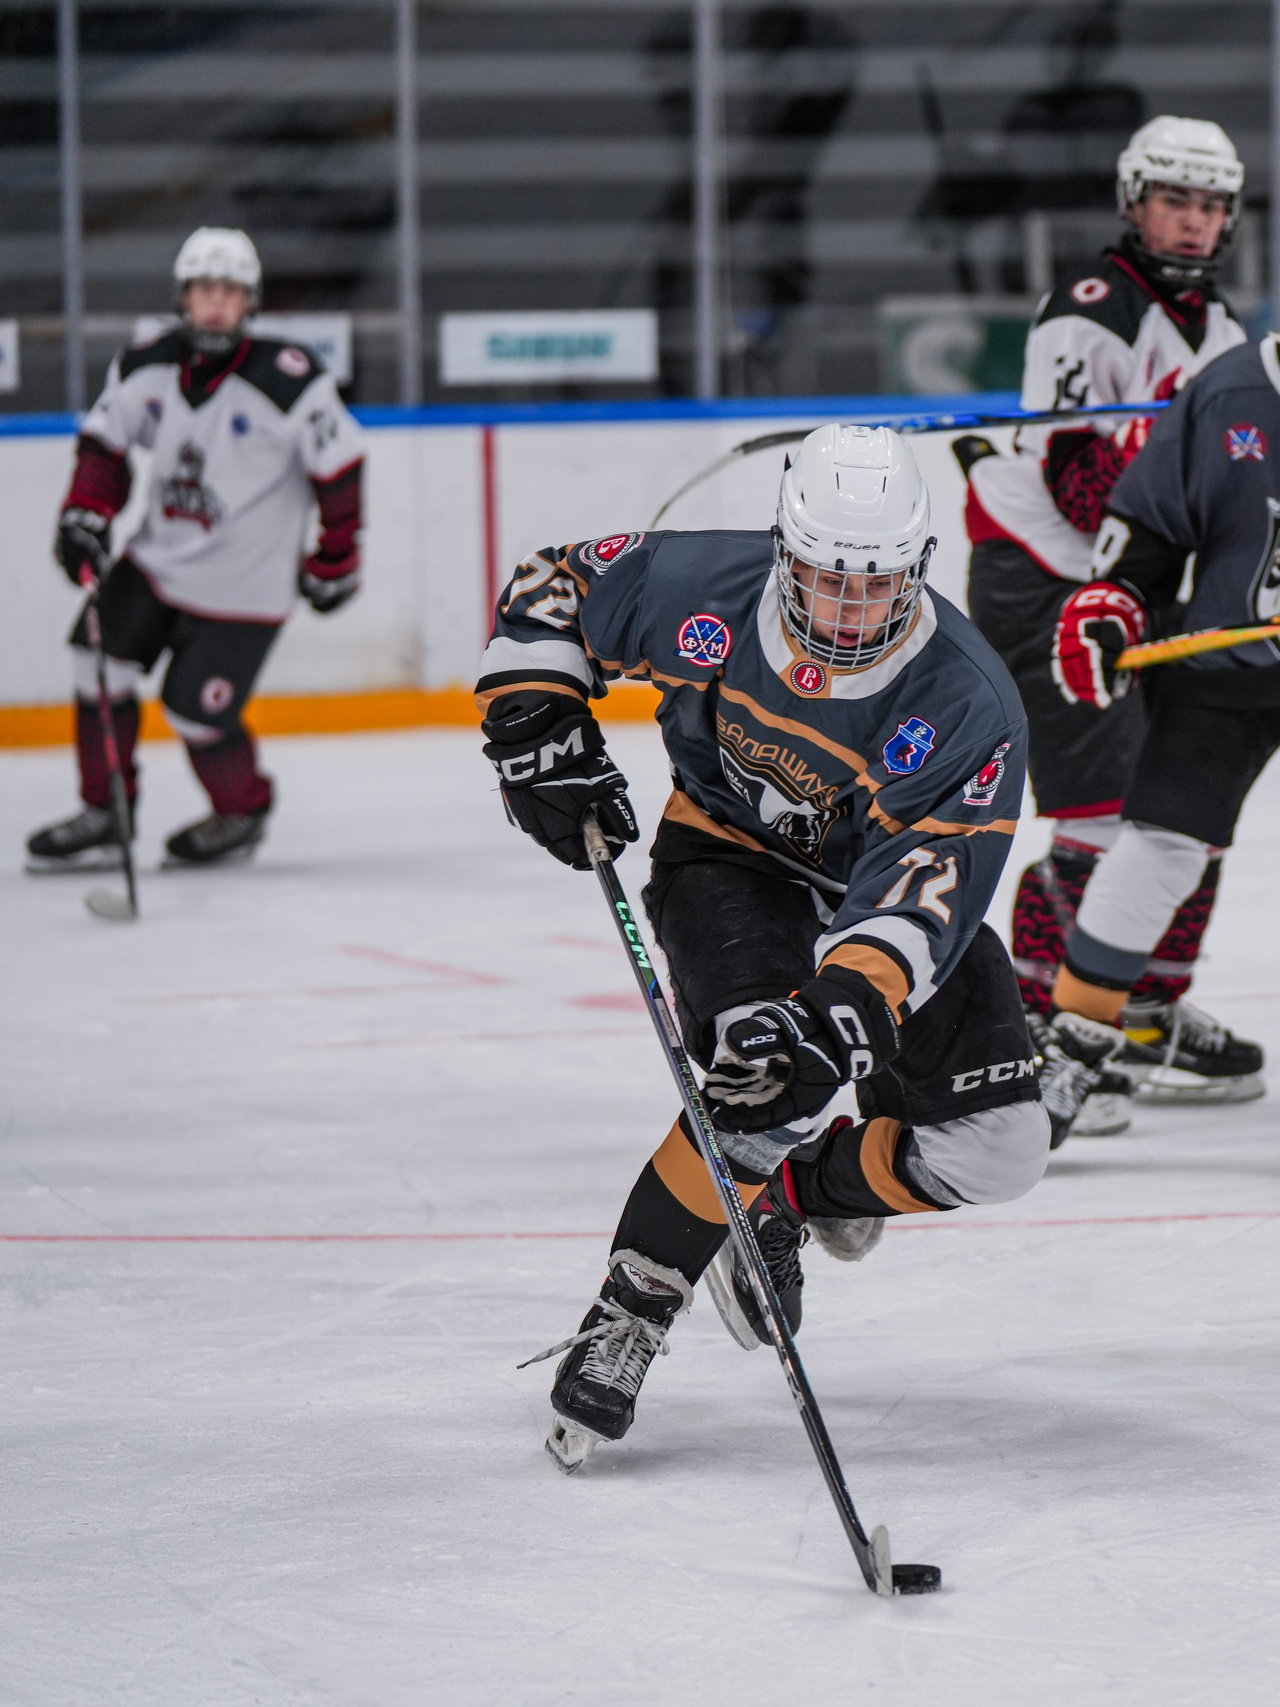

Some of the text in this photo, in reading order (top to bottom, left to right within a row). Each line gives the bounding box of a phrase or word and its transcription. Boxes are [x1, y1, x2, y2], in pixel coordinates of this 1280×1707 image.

[501, 552, 579, 630] 72
[613, 798, 635, 831] CCM
[876, 846, 958, 925] 72
[616, 901, 652, 968] CCM
[741, 1033, 777, 1048] CCM
[951, 1058, 1035, 1093] CCM
